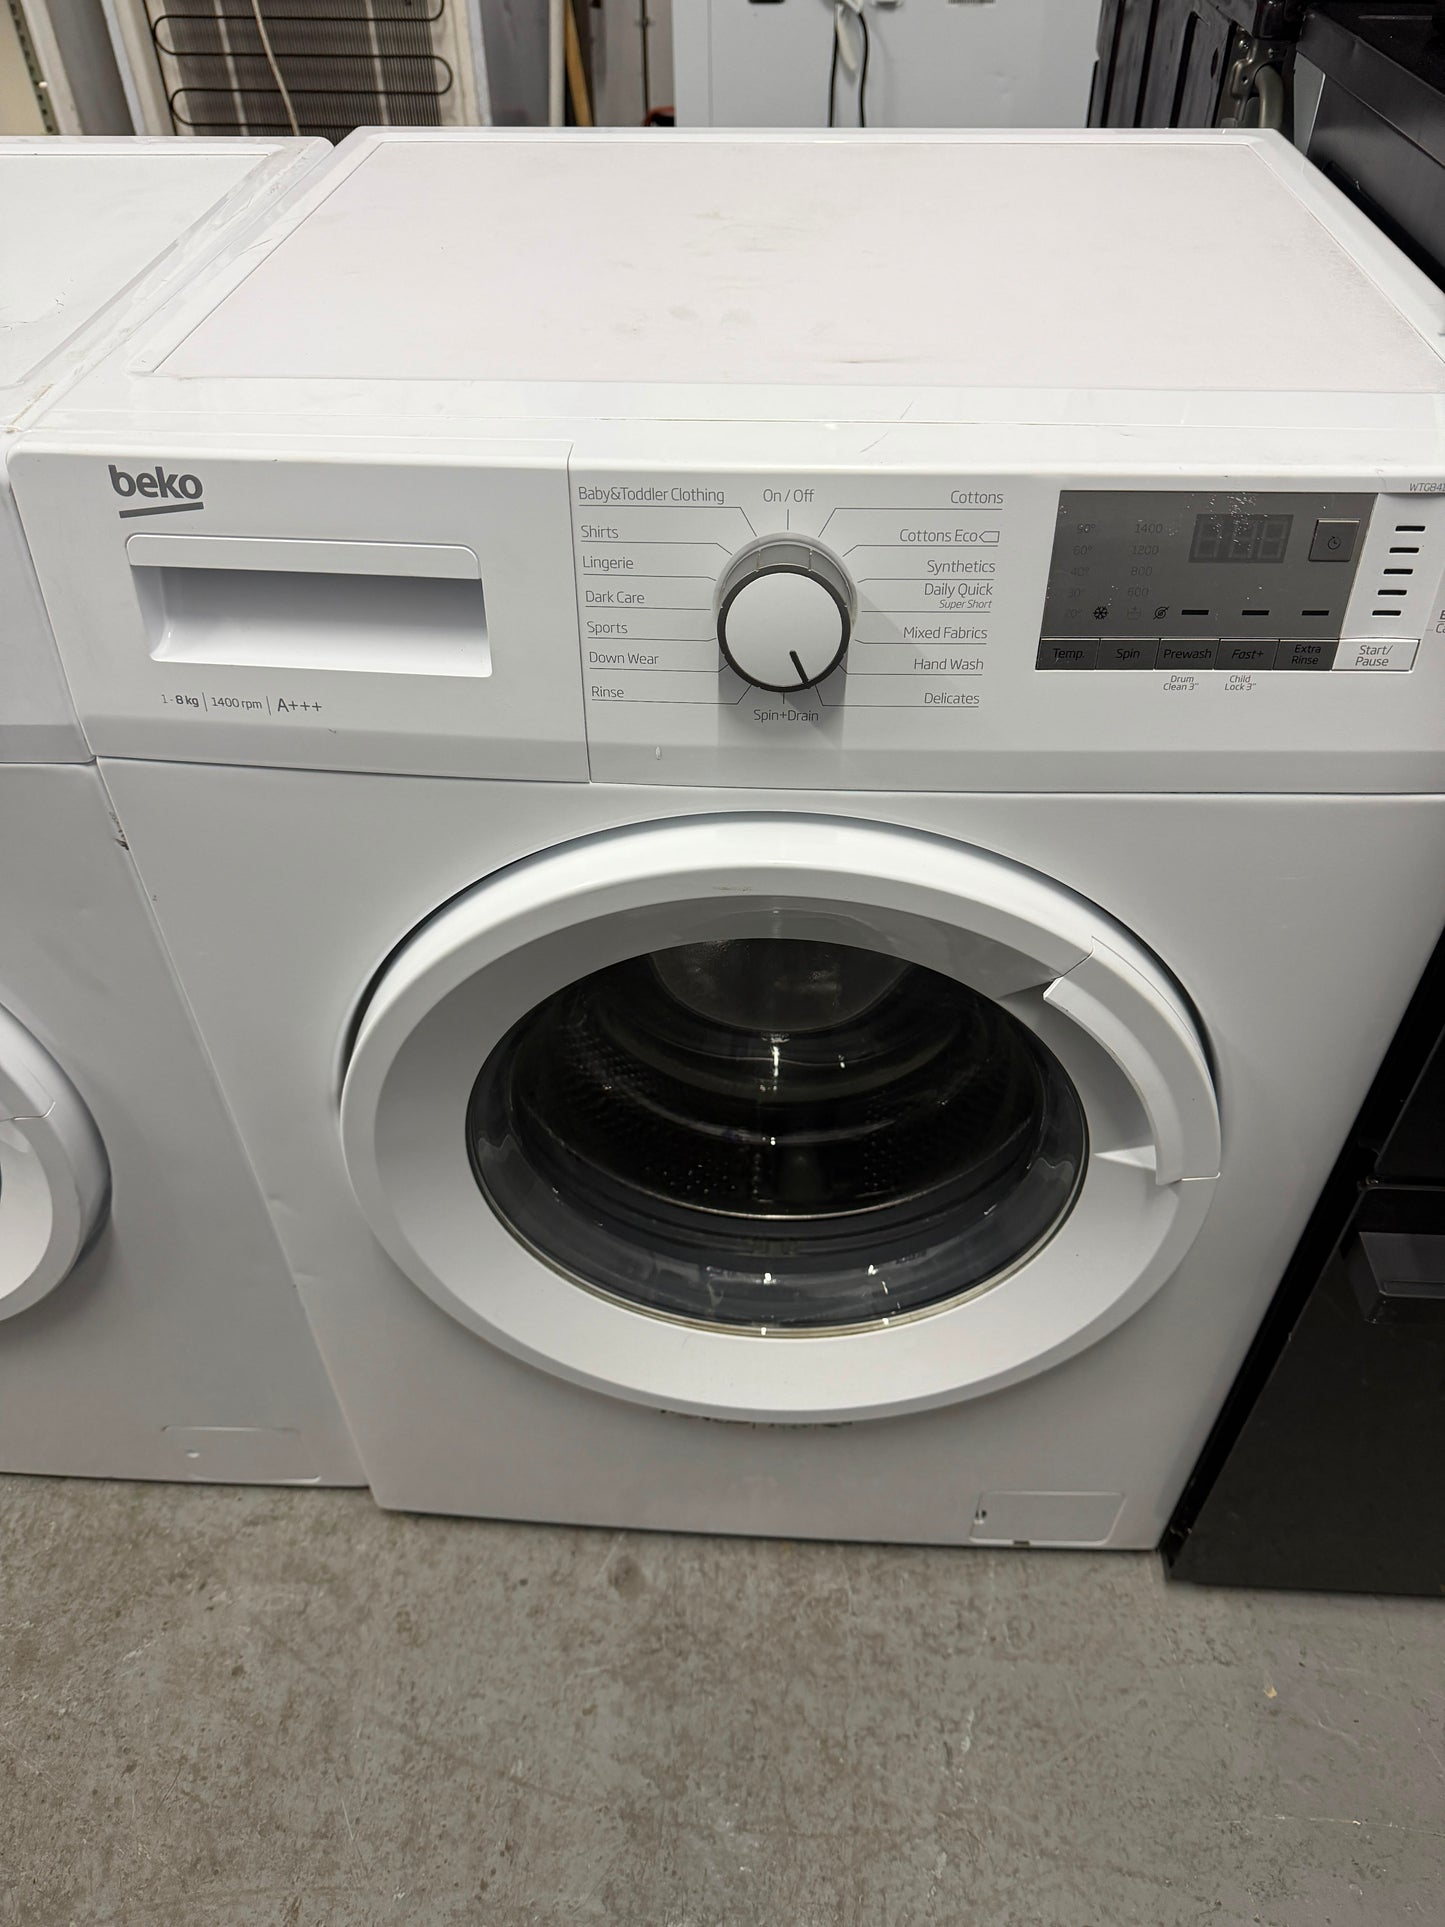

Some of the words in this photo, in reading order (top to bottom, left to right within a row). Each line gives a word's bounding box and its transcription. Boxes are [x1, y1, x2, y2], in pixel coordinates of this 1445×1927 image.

[108, 464, 204, 500] beko
[579, 487, 669, 504] Baby&Toddler
[671, 488, 725, 506] Clothing
[763, 489, 782, 503] On
[793, 489, 815, 503] Off
[950, 490, 1004, 505] Cottons
[580, 524, 619, 539] Shirts
[899, 528, 952, 543] Cottons
[954, 529, 978, 543] Eco
[582, 555, 634, 572] Lingerie
[926, 559, 996, 576] Synthetics
[585, 590, 614, 604] Dark
[616, 590, 645, 604] Care
[924, 582, 955, 599] Daily
[957, 583, 993, 599] Quick
[938, 599, 966, 611] Super
[966, 599, 993, 609] Short
[586, 620, 628, 636] Sports
[903, 626, 941, 639] Mixed
[943, 626, 988, 640] Fabrics
[1053, 647, 1085, 661] Temp.
[1115, 648, 1141, 661] Spin
[1163, 648, 1212, 659] Prewash
[1231, 648, 1264, 660] Fast+
[1294, 643, 1322, 654] Extra
[1358, 644, 1394, 656] Start/
[589, 651, 625, 664] Down
[627, 652, 659, 665] Wear
[913, 658, 947, 670] Hand
[949, 658, 984, 671] Wash
[1291, 655, 1319, 666] Rinse
[1355, 656, 1389, 667] Pause
[1169, 674, 1195, 684] Drum
[1229, 674, 1252, 684] Child
[591, 685, 625, 699] Rinse
[1162, 682, 1188, 691] Clean
[1224, 682, 1245, 691] Lock
[277, 697, 322, 713] A+++
[924, 691, 980, 705] Delicates
[753, 708, 819, 724] Spin+Drain
